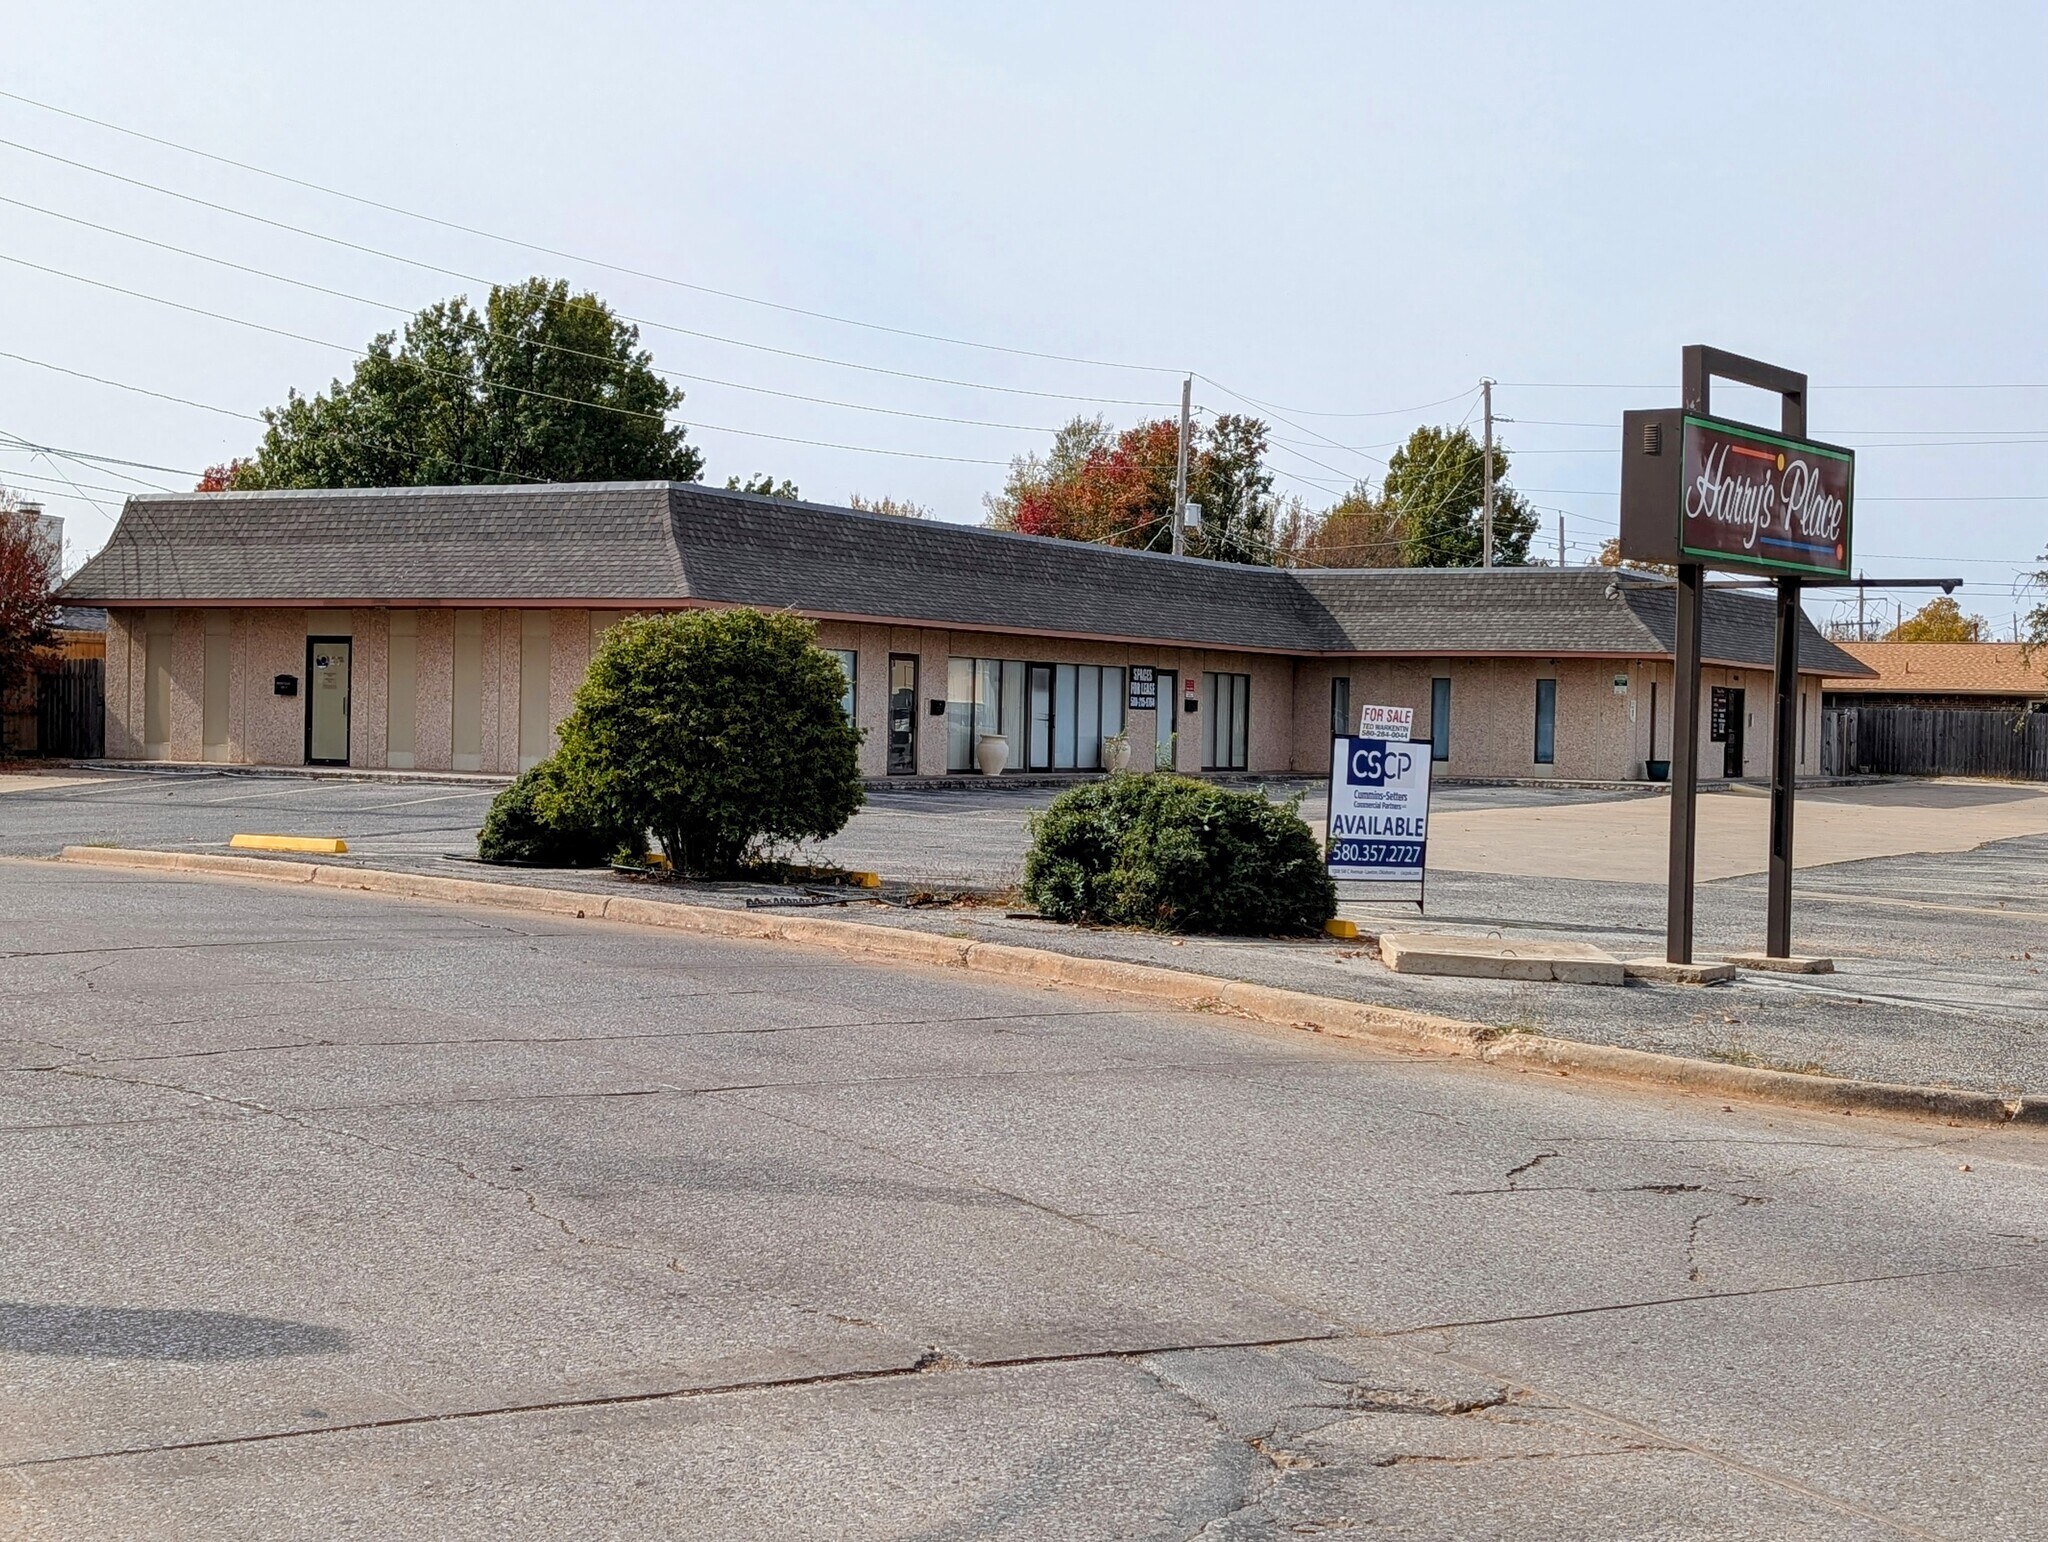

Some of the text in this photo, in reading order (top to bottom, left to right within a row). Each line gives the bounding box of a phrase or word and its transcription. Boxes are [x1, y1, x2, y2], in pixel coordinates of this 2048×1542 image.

[1685, 442, 1843, 549] Harry's Place
[1141, 682, 1155, 695] LEASE
[1364, 708, 1411, 724] FOR SALE
[1361, 730, 1408, 739] 580-284-0044
[1352, 749, 1412, 780] CSCP
[1353, 789, 1408, 802] Cummins-Setters
[1353, 801, 1381, 809] Commercial
[1332, 814, 1424, 837] AVAILABLE
[1332, 844, 1421, 863] 580.357.2727
